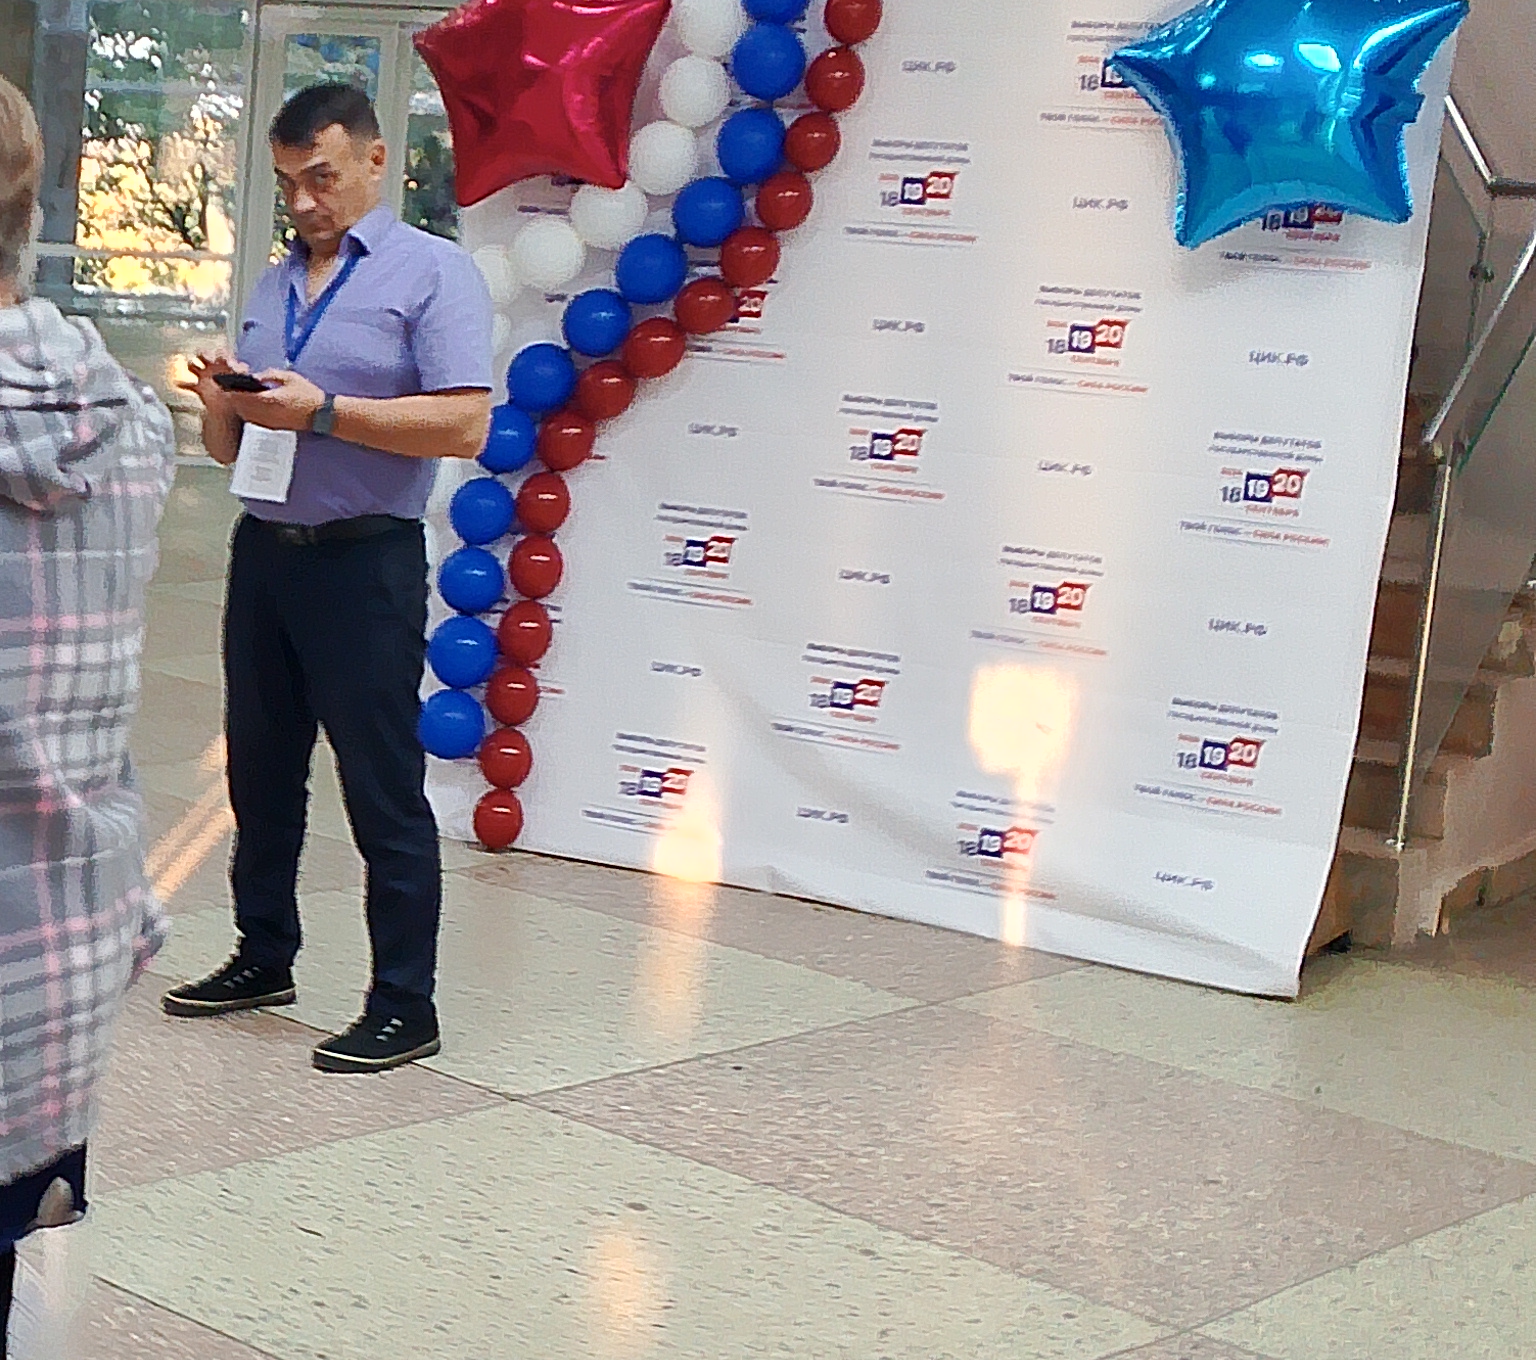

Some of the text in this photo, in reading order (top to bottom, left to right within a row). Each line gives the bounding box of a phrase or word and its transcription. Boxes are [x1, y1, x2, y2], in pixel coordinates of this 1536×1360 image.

[1079, 74, 1101, 90] 18
[1046, 325, 1124, 354] 18 19 20
[1220, 474, 1302, 502] 18 19 20
[1009, 587, 1085, 614] 18 19 20
[1177, 742, 1257, 768] 18 19 20
[1004, 830, 1034, 851] 20
